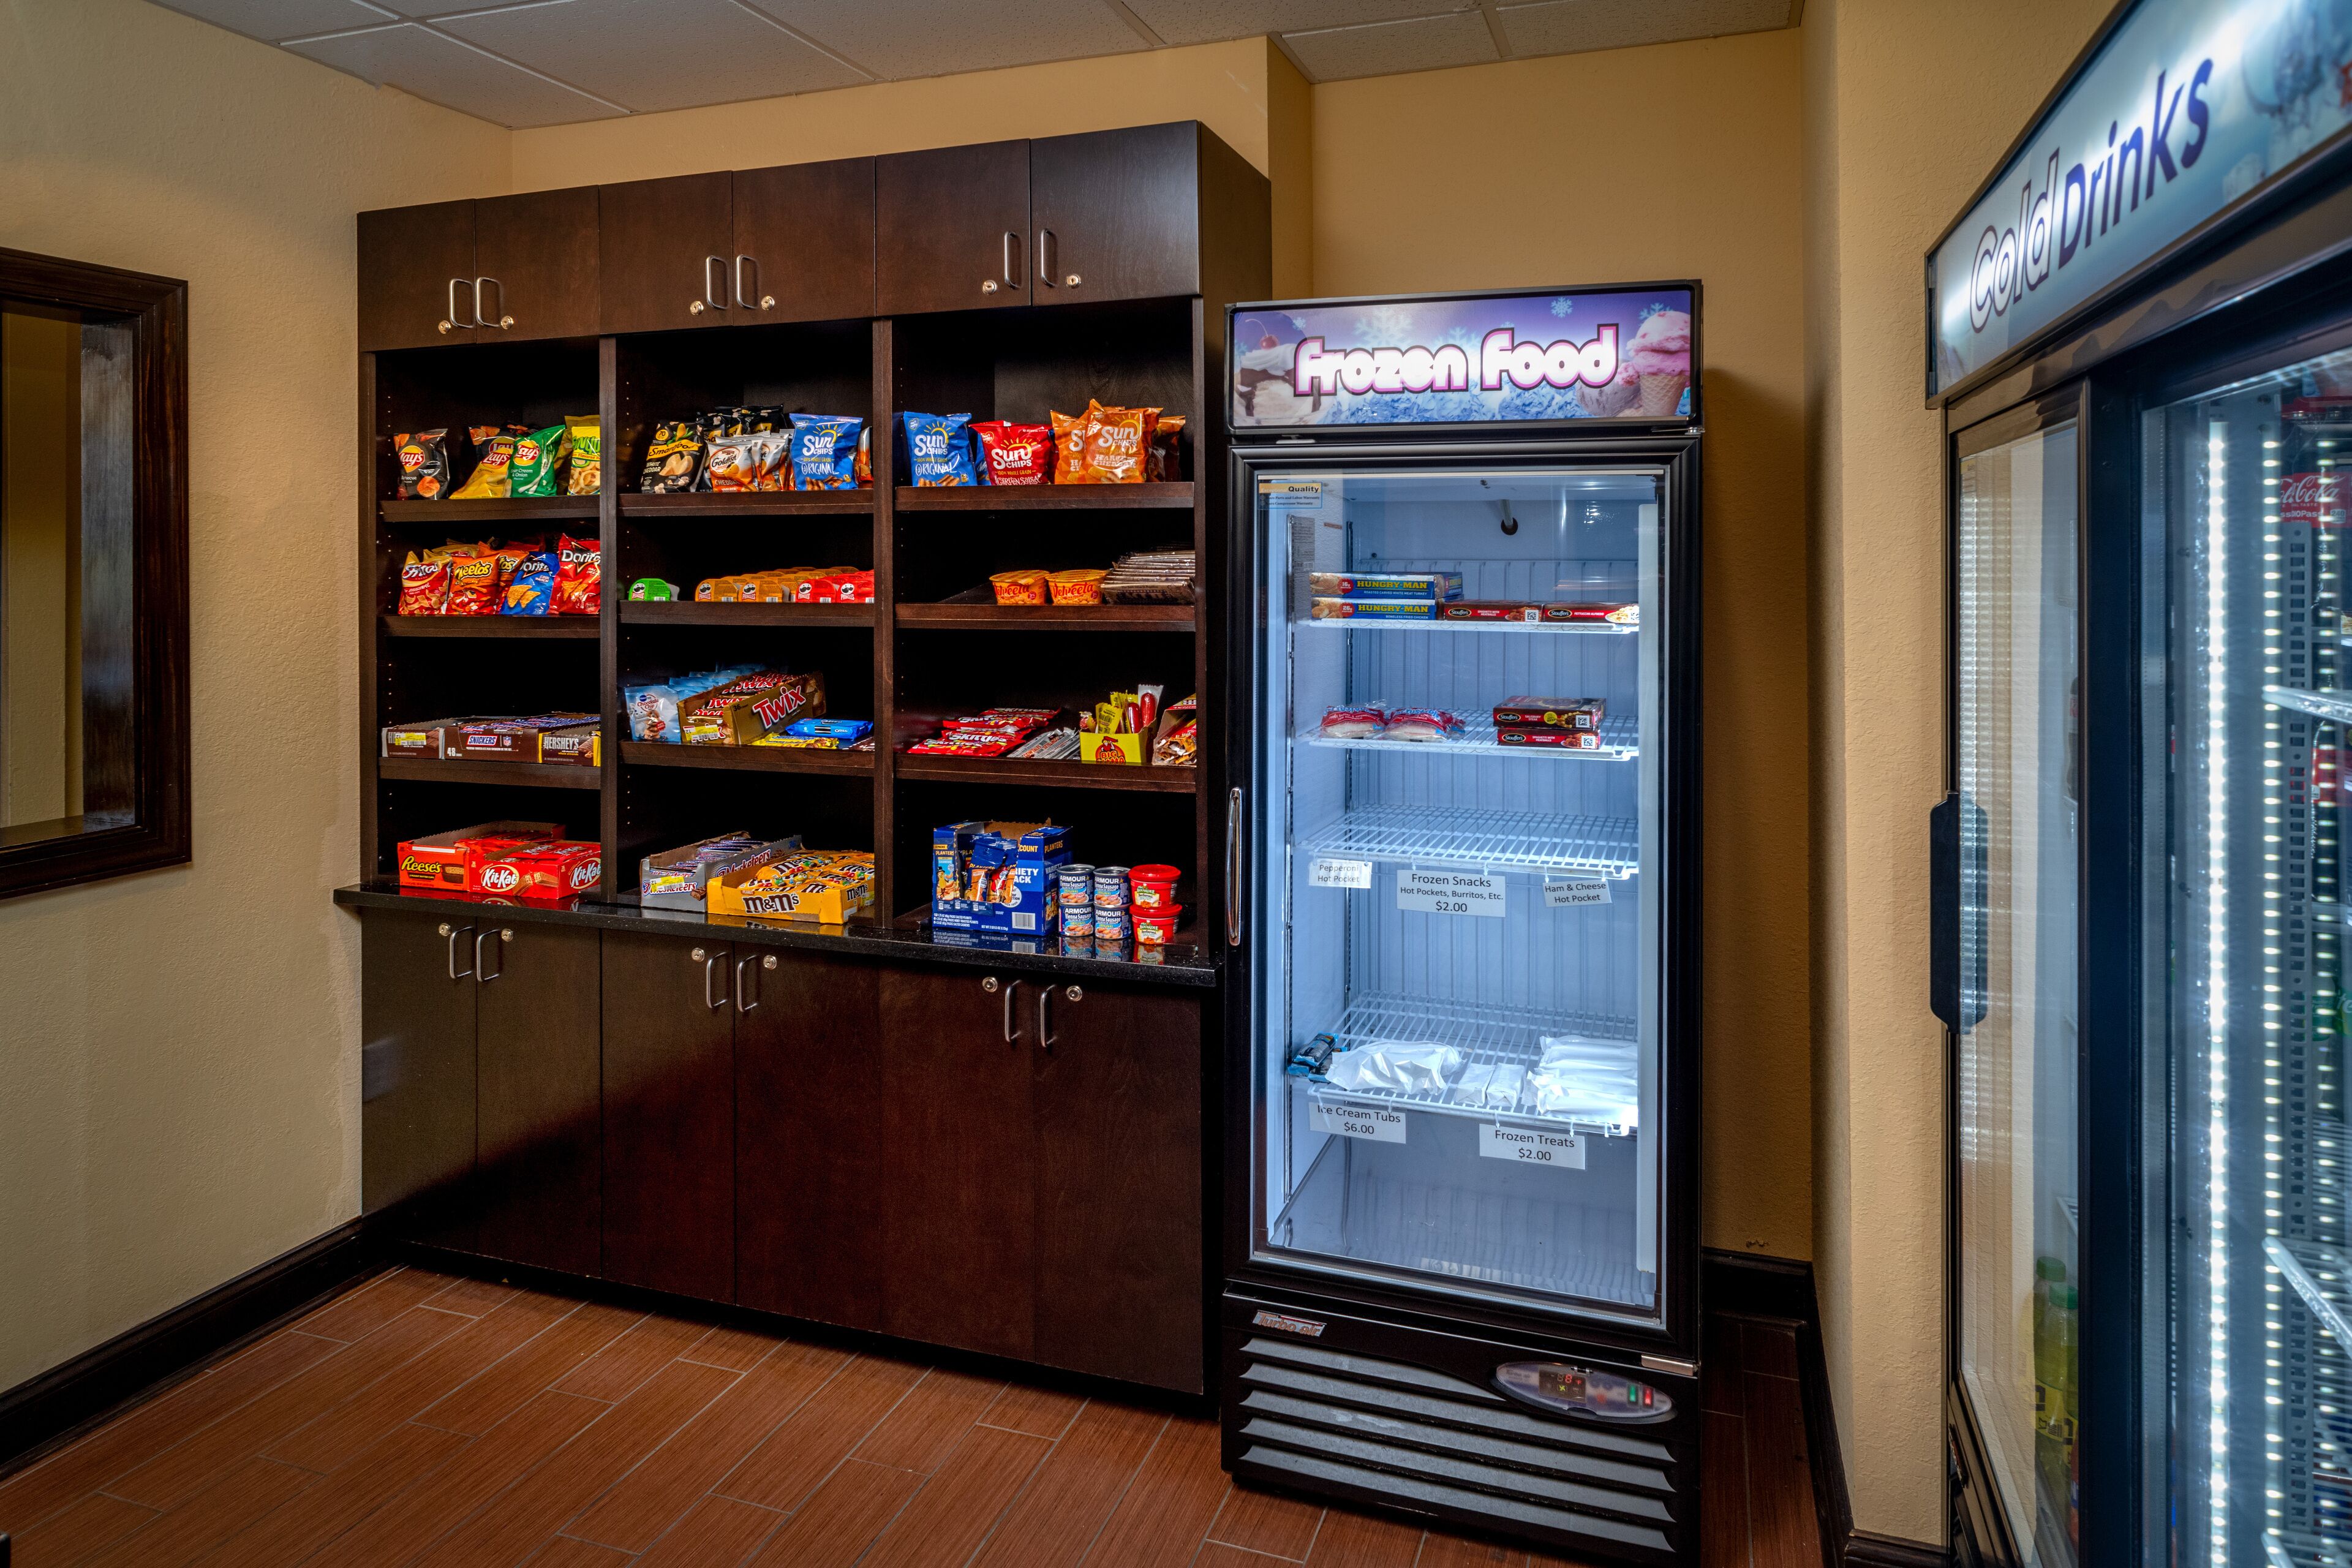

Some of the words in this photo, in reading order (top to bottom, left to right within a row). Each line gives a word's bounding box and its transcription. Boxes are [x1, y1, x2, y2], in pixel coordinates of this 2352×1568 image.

[1970, 146, 2060, 333] Cold
[2058, 58, 2213, 270] Drinks
[1098, 426, 1139, 447] Sun
[514, 445, 540, 460] Lay's
[802, 435, 834, 456] Sun
[914, 435, 948, 456] Sun
[483, 453, 510, 466] Lay's
[991, 448, 1030, 469] Sun
[801, 462, 839, 475] ORIGINAL
[402, 562, 439, 579] Fritos
[1054, 582, 1093, 598] Velveeta
[753, 685, 806, 729] Twix
[469, 736, 496, 745] SNICKERS
[543, 736, 579, 750] HERSHEY'S
[447, 747, 456, 756] 48
[1044, 840, 1063, 853] PLANTERS
[1412, 874, 1449, 885] Frozen
[1452, 876, 1491, 888] Snacks
[1417, 888, 1450, 897] Pockets,
[1452, 891, 1486, 900] Burritos,
[743, 893, 800, 914] m&m's
[1436, 900, 1468, 912] $2.00
[1317, 1105, 1333, 1114] Ice
[1335, 1107, 1371, 1119] Cream
[1374, 1111, 1401, 1123] Tubs
[1344, 1121, 1374, 1134] $6.00
[1495, 1129, 1534, 1144] Frozen
[1537, 1135, 1575, 1147] Treats
[1518, 1148, 1551, 1161] $2.00
[1257, 1313, 1296, 1332] Turbo
[1299, 1325, 1321, 1336] air
